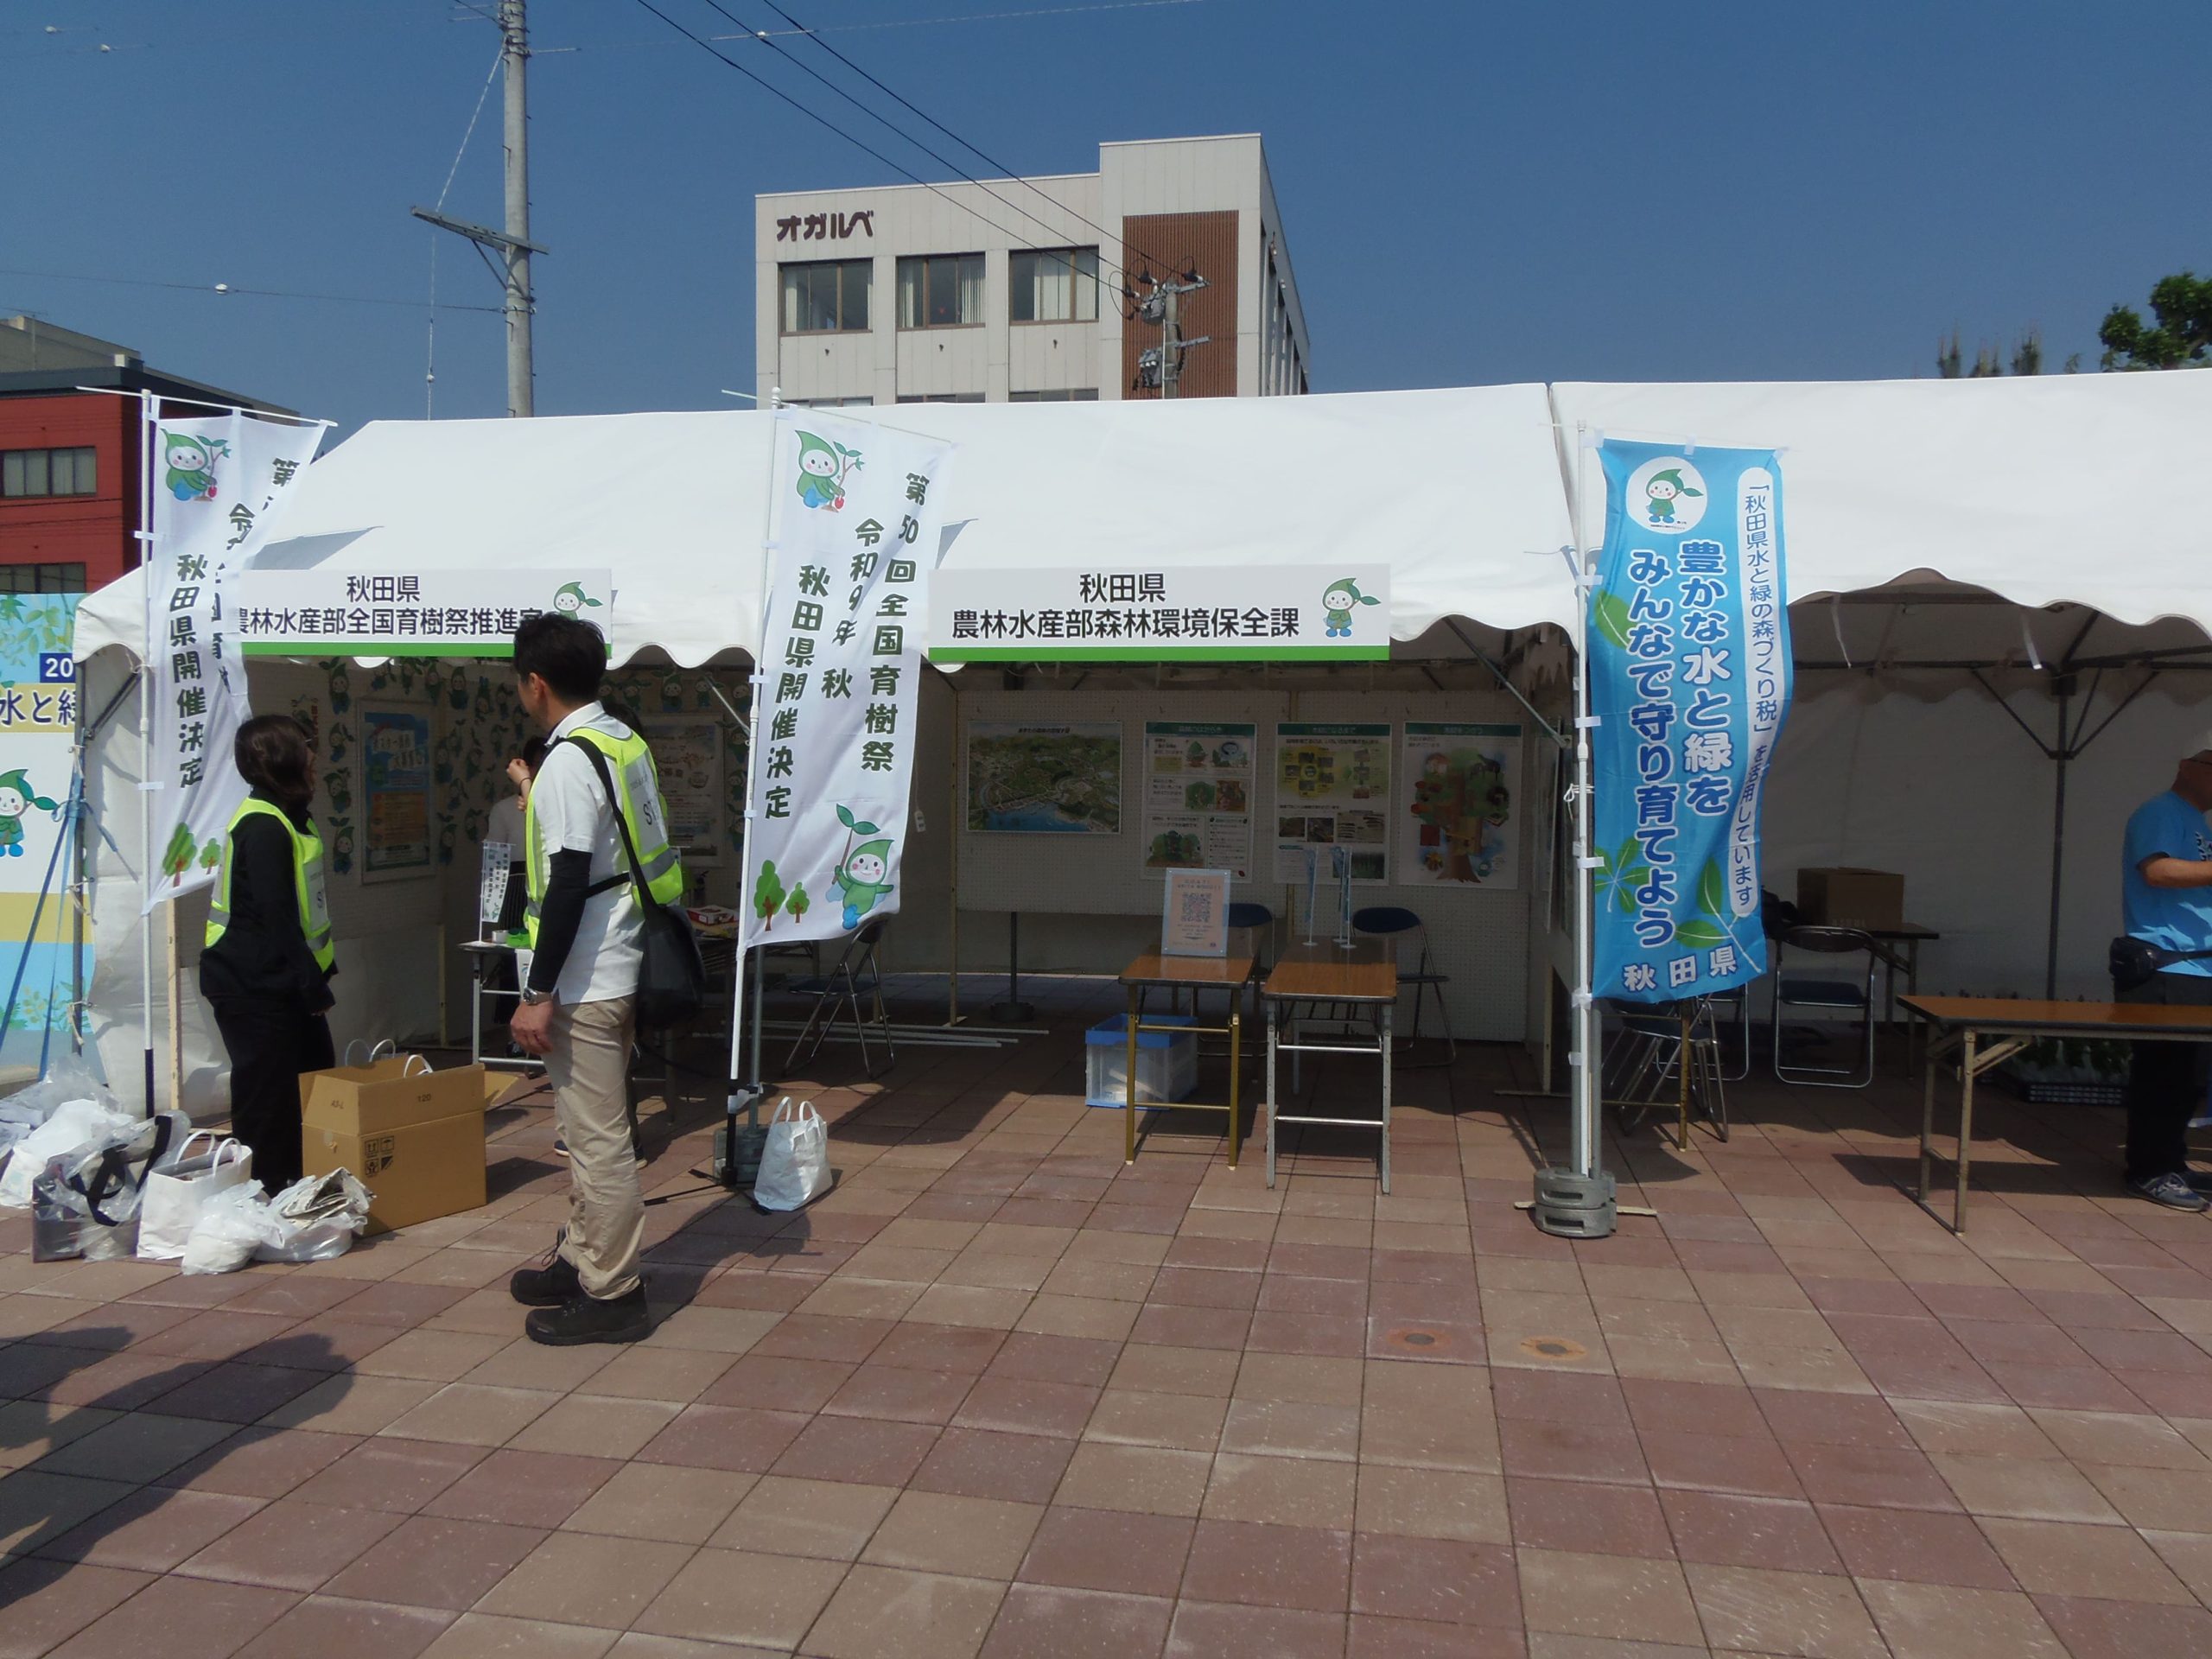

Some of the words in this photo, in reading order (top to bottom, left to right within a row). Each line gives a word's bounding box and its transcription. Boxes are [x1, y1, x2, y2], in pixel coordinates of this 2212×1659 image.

[777, 210, 874, 242] オガルベ
[346, 575, 420, 603] 秋田県
[861, 472, 931, 772] 第50回全国育樹祭
[952, 607, 1300, 639] 農林水産部森林環境保全課
[1079, 573, 1166, 603] 秋田県
[169, 554, 207, 788] 秋田県開催決定
[764, 564, 831, 821] 秋田県開催決定
[1678, 539, 1731, 817] 豊かな水と緑を
[1626, 550, 1676, 949] みんなで守り育てよう
[1623, 944, 1738, 992] 秋田県
